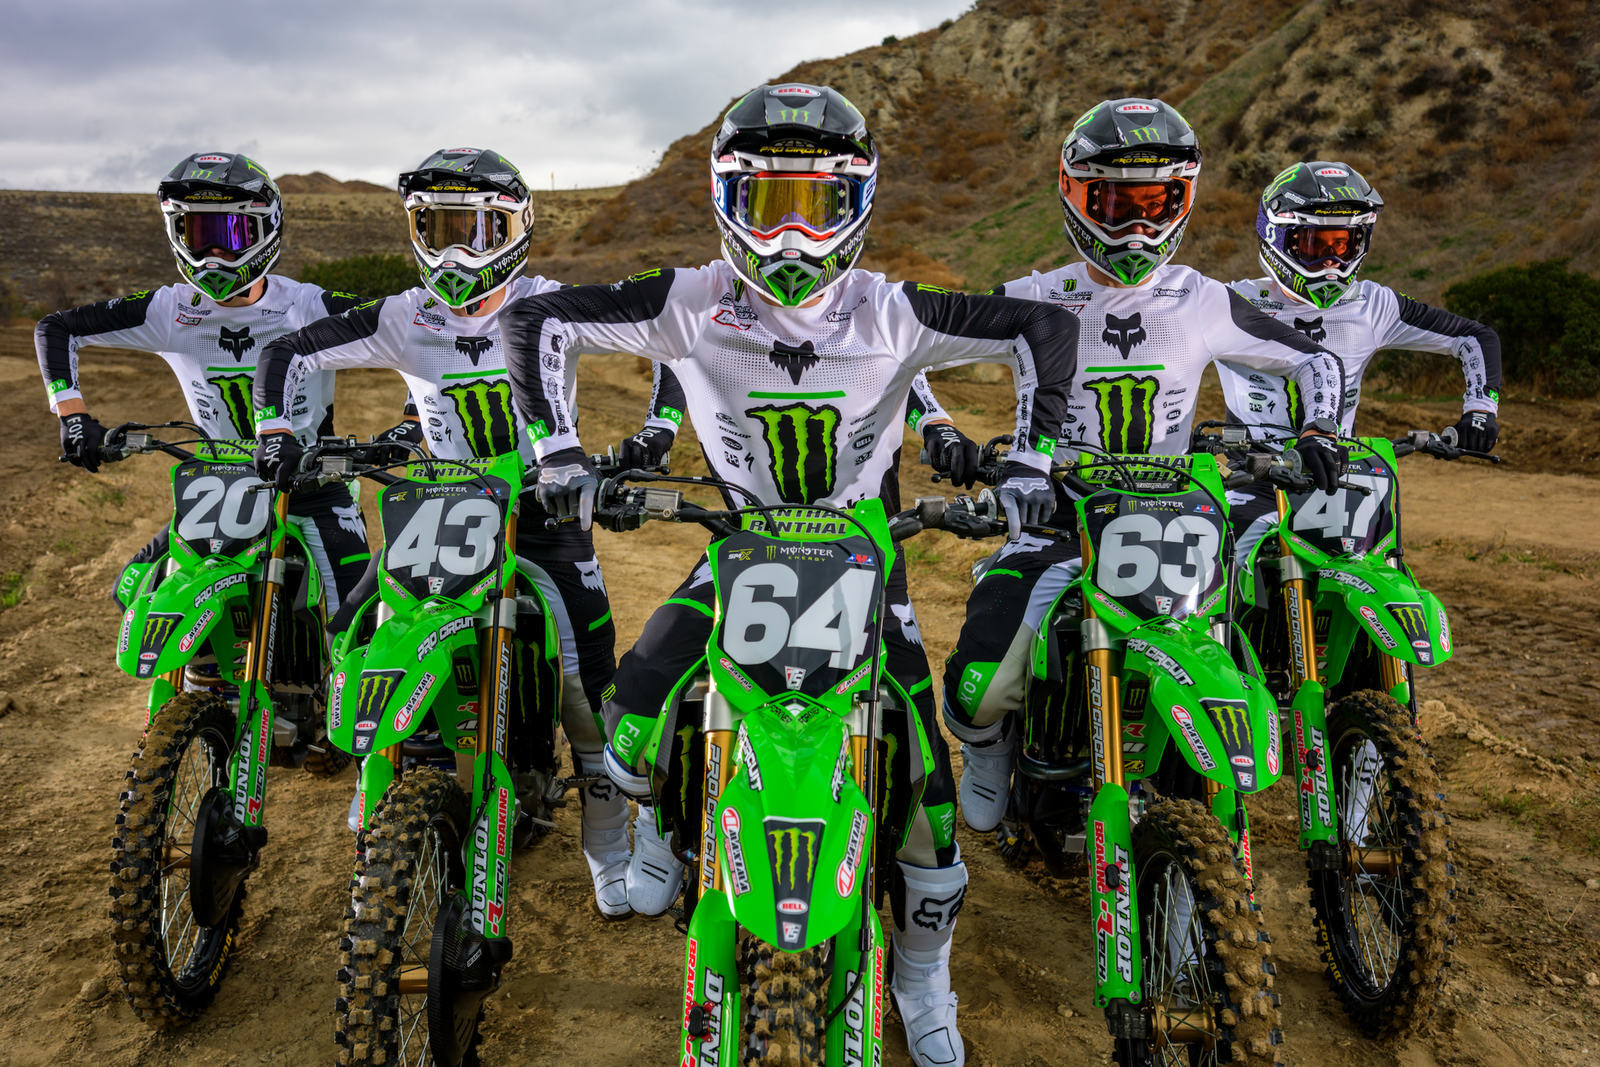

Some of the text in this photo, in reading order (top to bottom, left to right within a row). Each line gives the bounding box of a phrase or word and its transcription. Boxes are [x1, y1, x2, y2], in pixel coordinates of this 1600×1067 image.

[493, 241, 530, 272] MONSTER
[67, 416, 84, 446] FOX
[388, 422, 416, 443] FOX
[633, 426, 663, 448] FOX
[719, 425, 751, 439] DUNLOP
[856, 436, 872, 448] BELL
[937, 426, 962, 449] FOX
[264, 436, 282, 467] FOX
[178, 475, 275, 541] 20
[426, 486, 467, 494] MONSTER
[1094, 503, 1118, 514] SMX
[1140, 499, 1185, 509] MONSTER
[1193, 504, 1216, 514] AMA
[1293, 473, 1389, 539] 47
[387, 498, 501, 578] 43
[749, 519, 847, 535] RENTHAL
[728, 548, 754, 561] SMX
[780, 546, 834, 558] MONSTER
[845, 553, 875, 566] AMA
[1097, 513, 1220, 598] 63
[119, 567, 140, 597] FOX
[193, 573, 248, 608] PRO CIRCUIT
[1333, 571, 1378, 595] CIRCUIT
[189, 608, 213, 640] MAXIMA
[723, 562, 877, 671] 64
[1288, 586, 1306, 678] PRO CIRCUIT
[1369, 615, 1398, 650] MAXIMA
[266, 592, 280, 684] CIRCUIT PRO
[417, 615, 474, 663] PRO CIRCUIT
[1127, 637, 1196, 688] PRO CIRCUIT
[405, 671, 433, 715] MAXIMA
[495, 641, 512, 757] CIRCUIT PRO
[959, 667, 984, 706] FOX
[769, 704, 793, 725] FORKNER
[798, 705, 821, 726] FORKNER
[1090, 664, 1106, 786] PRO CIRCUIT
[1267, 709, 1278, 756] MAXIMA
[258, 707, 271, 763] BRAKING
[615, 719, 641, 758] FOX
[1182, 720, 1217, 770] MAXIMA
[1294, 710, 1306, 764] BRAKING
[496, 786, 509, 858] BRAKING
[702, 742, 722, 890] PRO CIRCUIT
[845, 808, 865, 873] MAXIMA
[1093, 819, 1107, 895] BRAKING
[728, 828, 751, 894] MAXIMA
[782, 903, 804, 911] BELL
[683, 937, 698, 1031] BRAKING
[872, 945, 884, 1041] BRAKING
